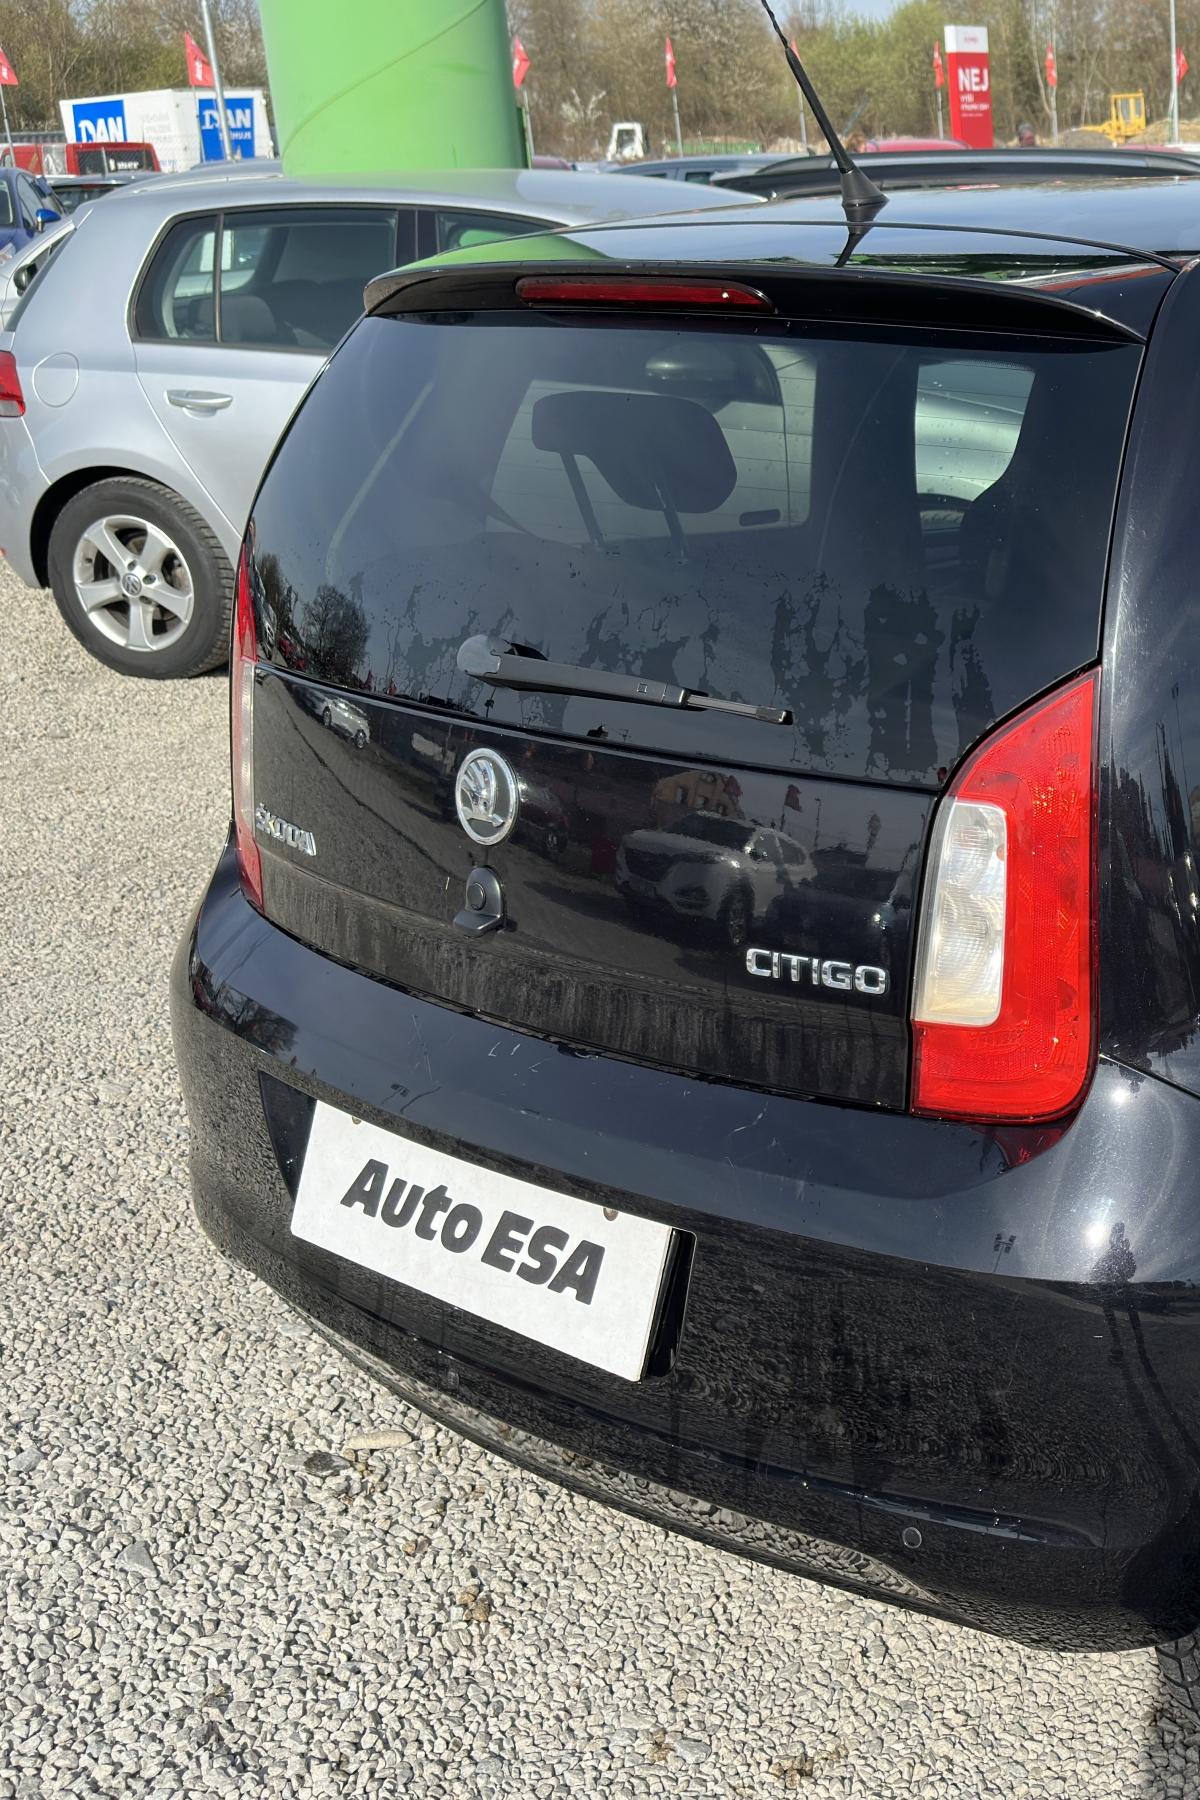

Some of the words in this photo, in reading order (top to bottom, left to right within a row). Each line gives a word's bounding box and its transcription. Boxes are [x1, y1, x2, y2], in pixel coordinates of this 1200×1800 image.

[958, 67, 989, 92] NEJ
[78, 116, 125, 143] DAN
[745, 948, 889, 995] CITIGO
[340, 1158, 483, 1253] Auto
[480, 1209, 605, 1305] ESA
